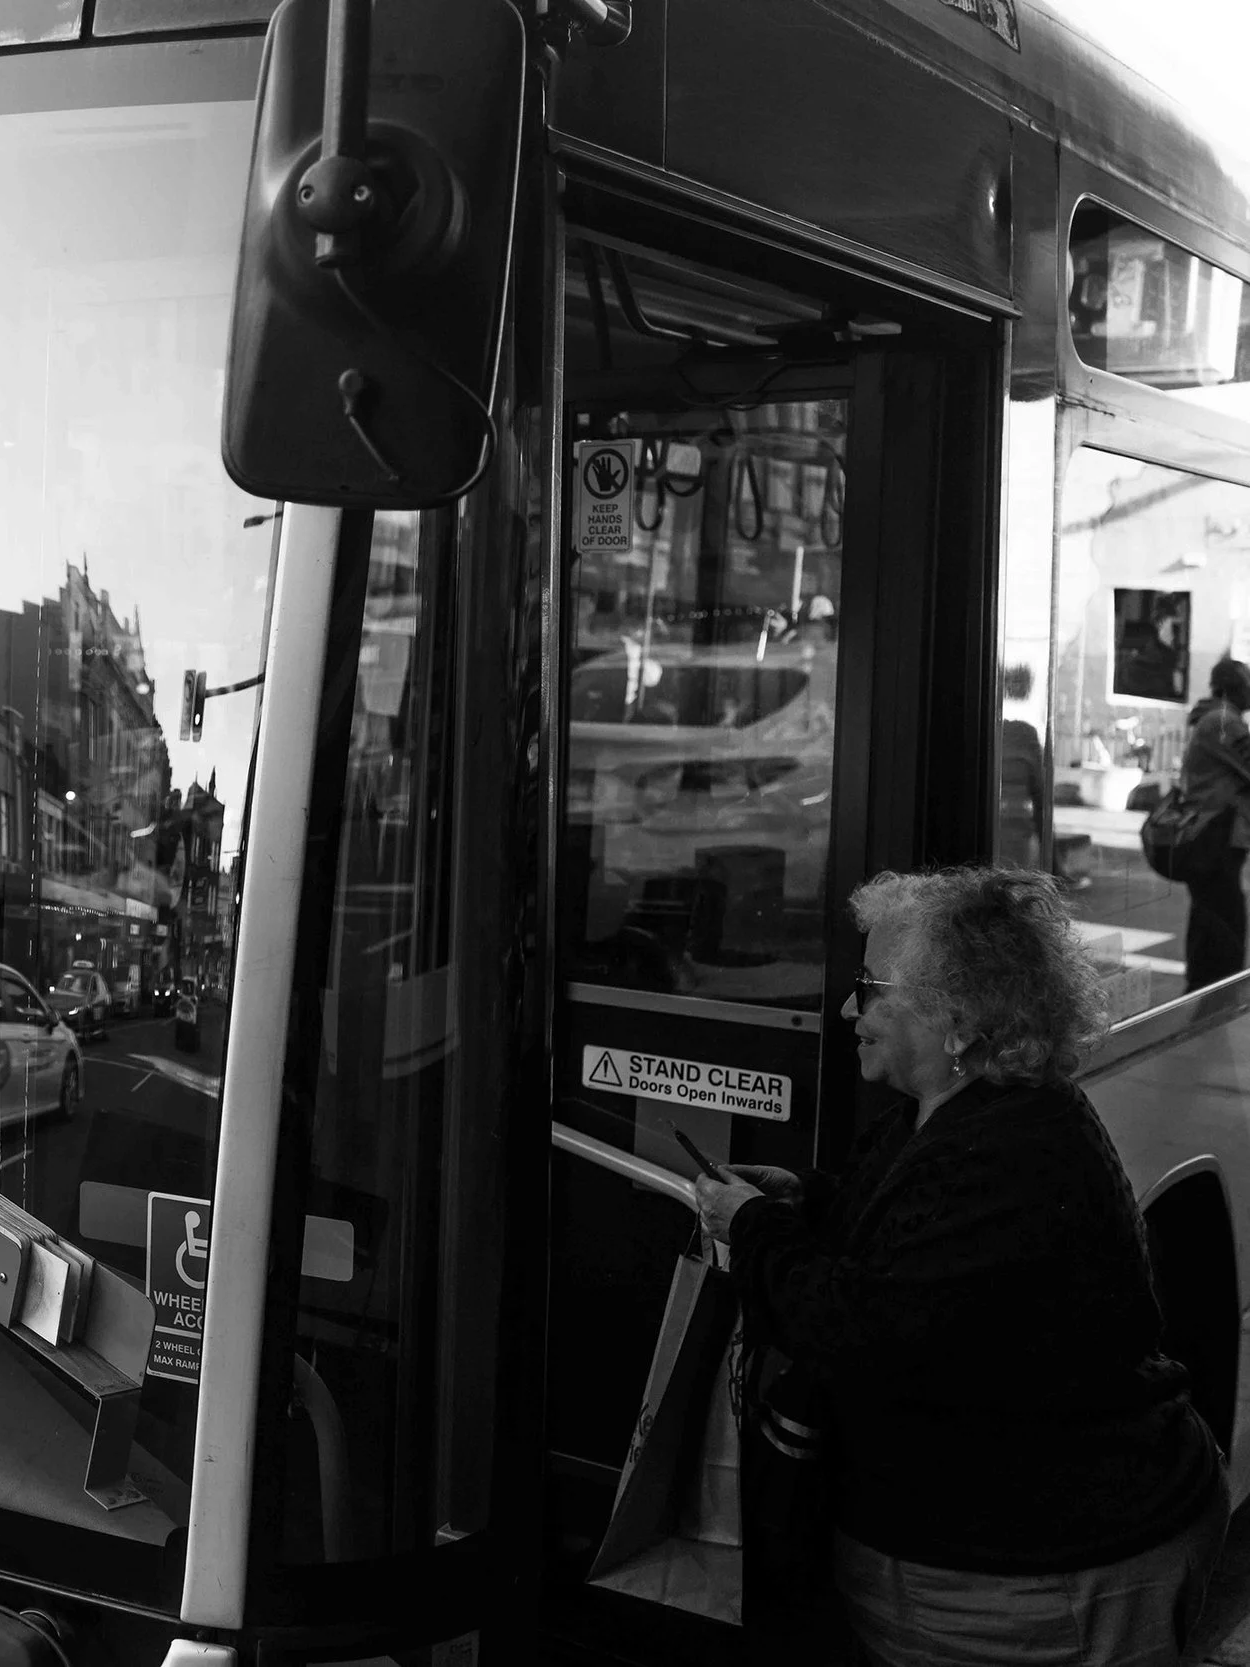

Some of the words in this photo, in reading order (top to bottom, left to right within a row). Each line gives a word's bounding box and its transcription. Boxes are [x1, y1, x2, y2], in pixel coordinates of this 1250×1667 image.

[592, 504, 619, 513] KEEP
[588, 514, 623, 524] HANDS
[588, 525, 622, 535] CLEAR
[582, 536, 596, 546] OF
[597, 536, 628, 546] DOOR
[629, 1054, 701, 1083] STAND
[708, 1068, 784, 1097] CLEAR
[629, 1076, 672, 1095] Doors
[677, 1084, 717, 1104] Open
[721, 1091, 783, 1114] Inwards
[153, 1290, 204, 1313] WHEE
[155, 1340, 161, 1349] 2
[162, 1341, 195, 1355] WHEEL
[153, 1354, 174, 1366] MAX
